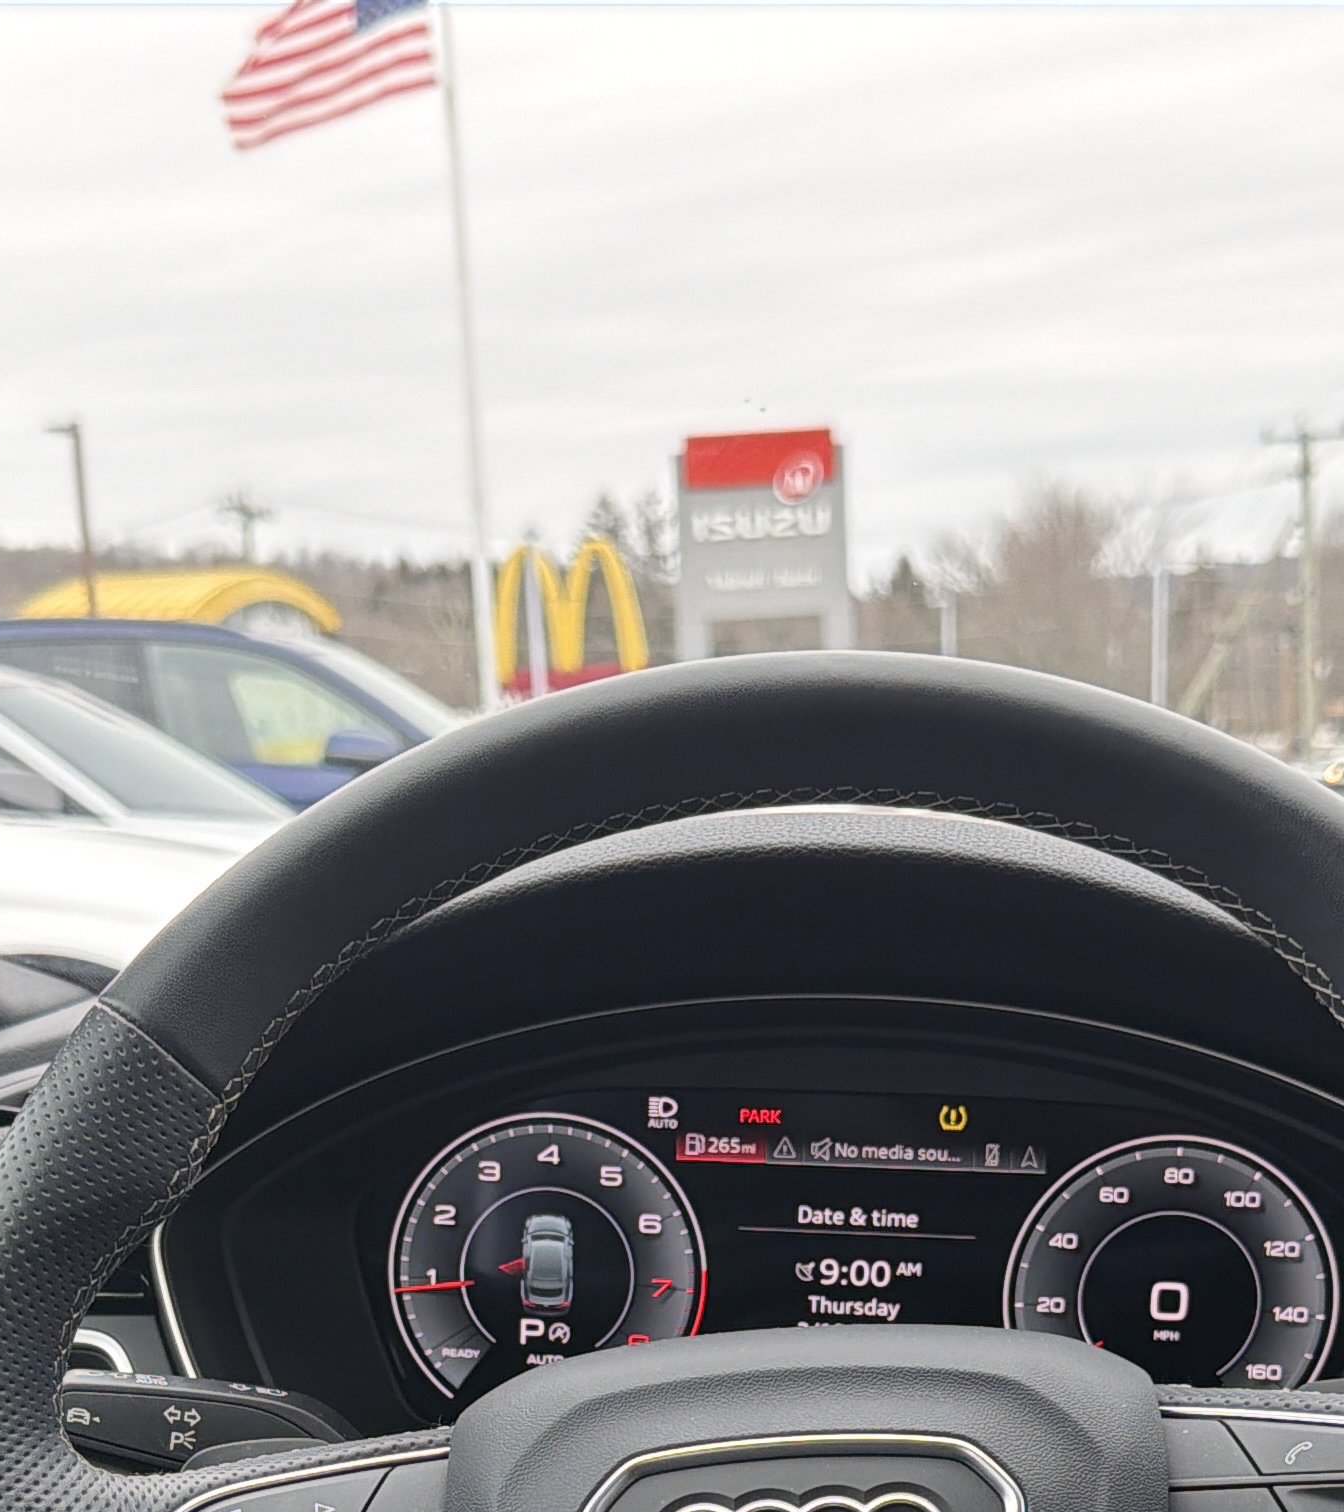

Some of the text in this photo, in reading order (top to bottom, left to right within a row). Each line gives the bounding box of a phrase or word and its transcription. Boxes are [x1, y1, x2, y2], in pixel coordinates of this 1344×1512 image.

[647, 1118, 679, 1130] AUTO
[739, 1108, 782, 1125] PARK
[536, 1144, 561, 1165] 4
[834, 1141, 960, 1163] No media sou...
[478, 1162, 501, 1182] 3
[600, 1165, 623, 1187] 5
[1164, 1167, 1194, 1185] 80
[1099, 1186, 1129, 1204] 60
[1224, 1190, 1261, 1209] 100
[435, 1205, 456, 1225] 2
[638, 1212, 662, 1235] 6
[798, 1205, 919, 1229] Date & time
[1048, 1232, 1079, 1250] 40
[1264, 1240, 1301, 1258] 120
[426, 1269, 438, 1285] 1
[818, 1258, 922, 1288] 9:00 AM
[651, 1278, 673, 1298] 7
[808, 1295, 900, 1321] Thursday
[1036, 1296, 1066, 1313] 20
[1150, 1282, 1190, 1321] 0
[1273, 1306, 1309, 1324] 140
[519, 1318, 544, 1345] P
[1153, 1330, 1180, 1342] MPH
[441, 1347, 480, 1359] READY
[1246, 1364, 1283, 1381] 160
